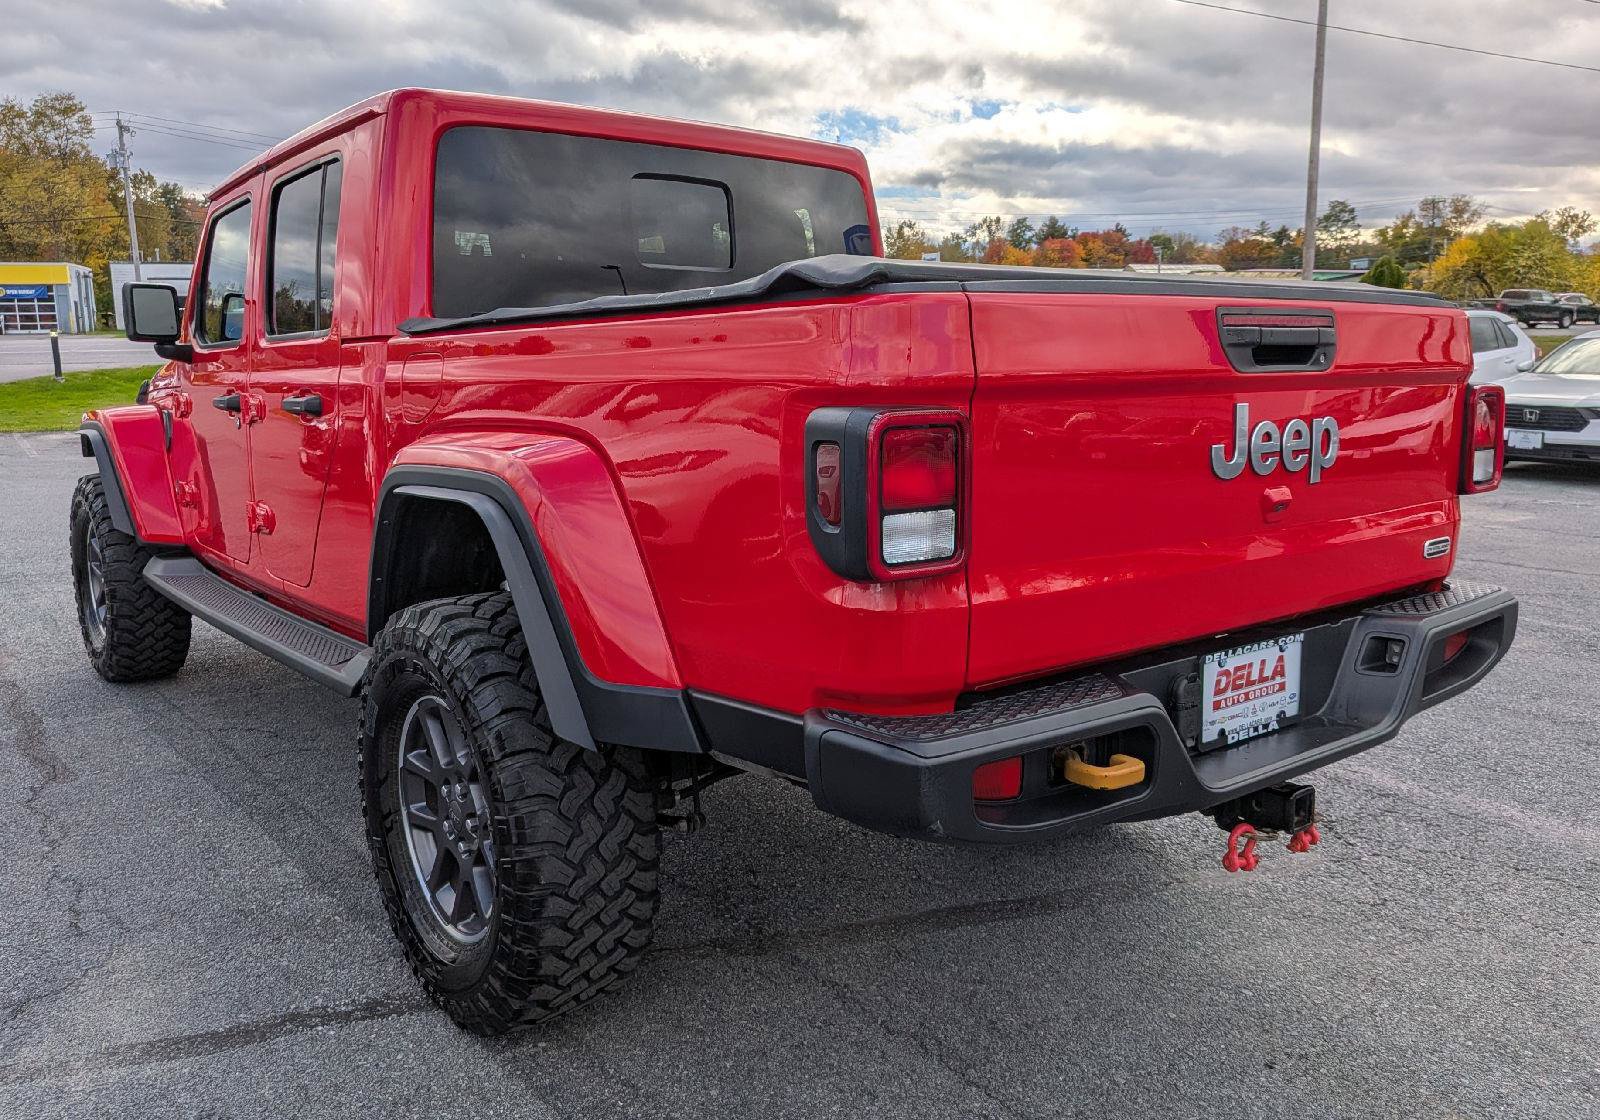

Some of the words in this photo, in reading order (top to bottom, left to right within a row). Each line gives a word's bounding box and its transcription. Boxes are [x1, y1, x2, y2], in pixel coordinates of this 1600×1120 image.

[1211, 402, 1340, 484] Jeep
[1205, 633, 1305, 664] DELLACARS.COM
[1213, 655, 1286, 697] DELLA
[1220, 692, 1246, 709] AUTO
[1248, 683, 1280, 700] GROUP
[1227, 721, 1280, 745] DELLA
